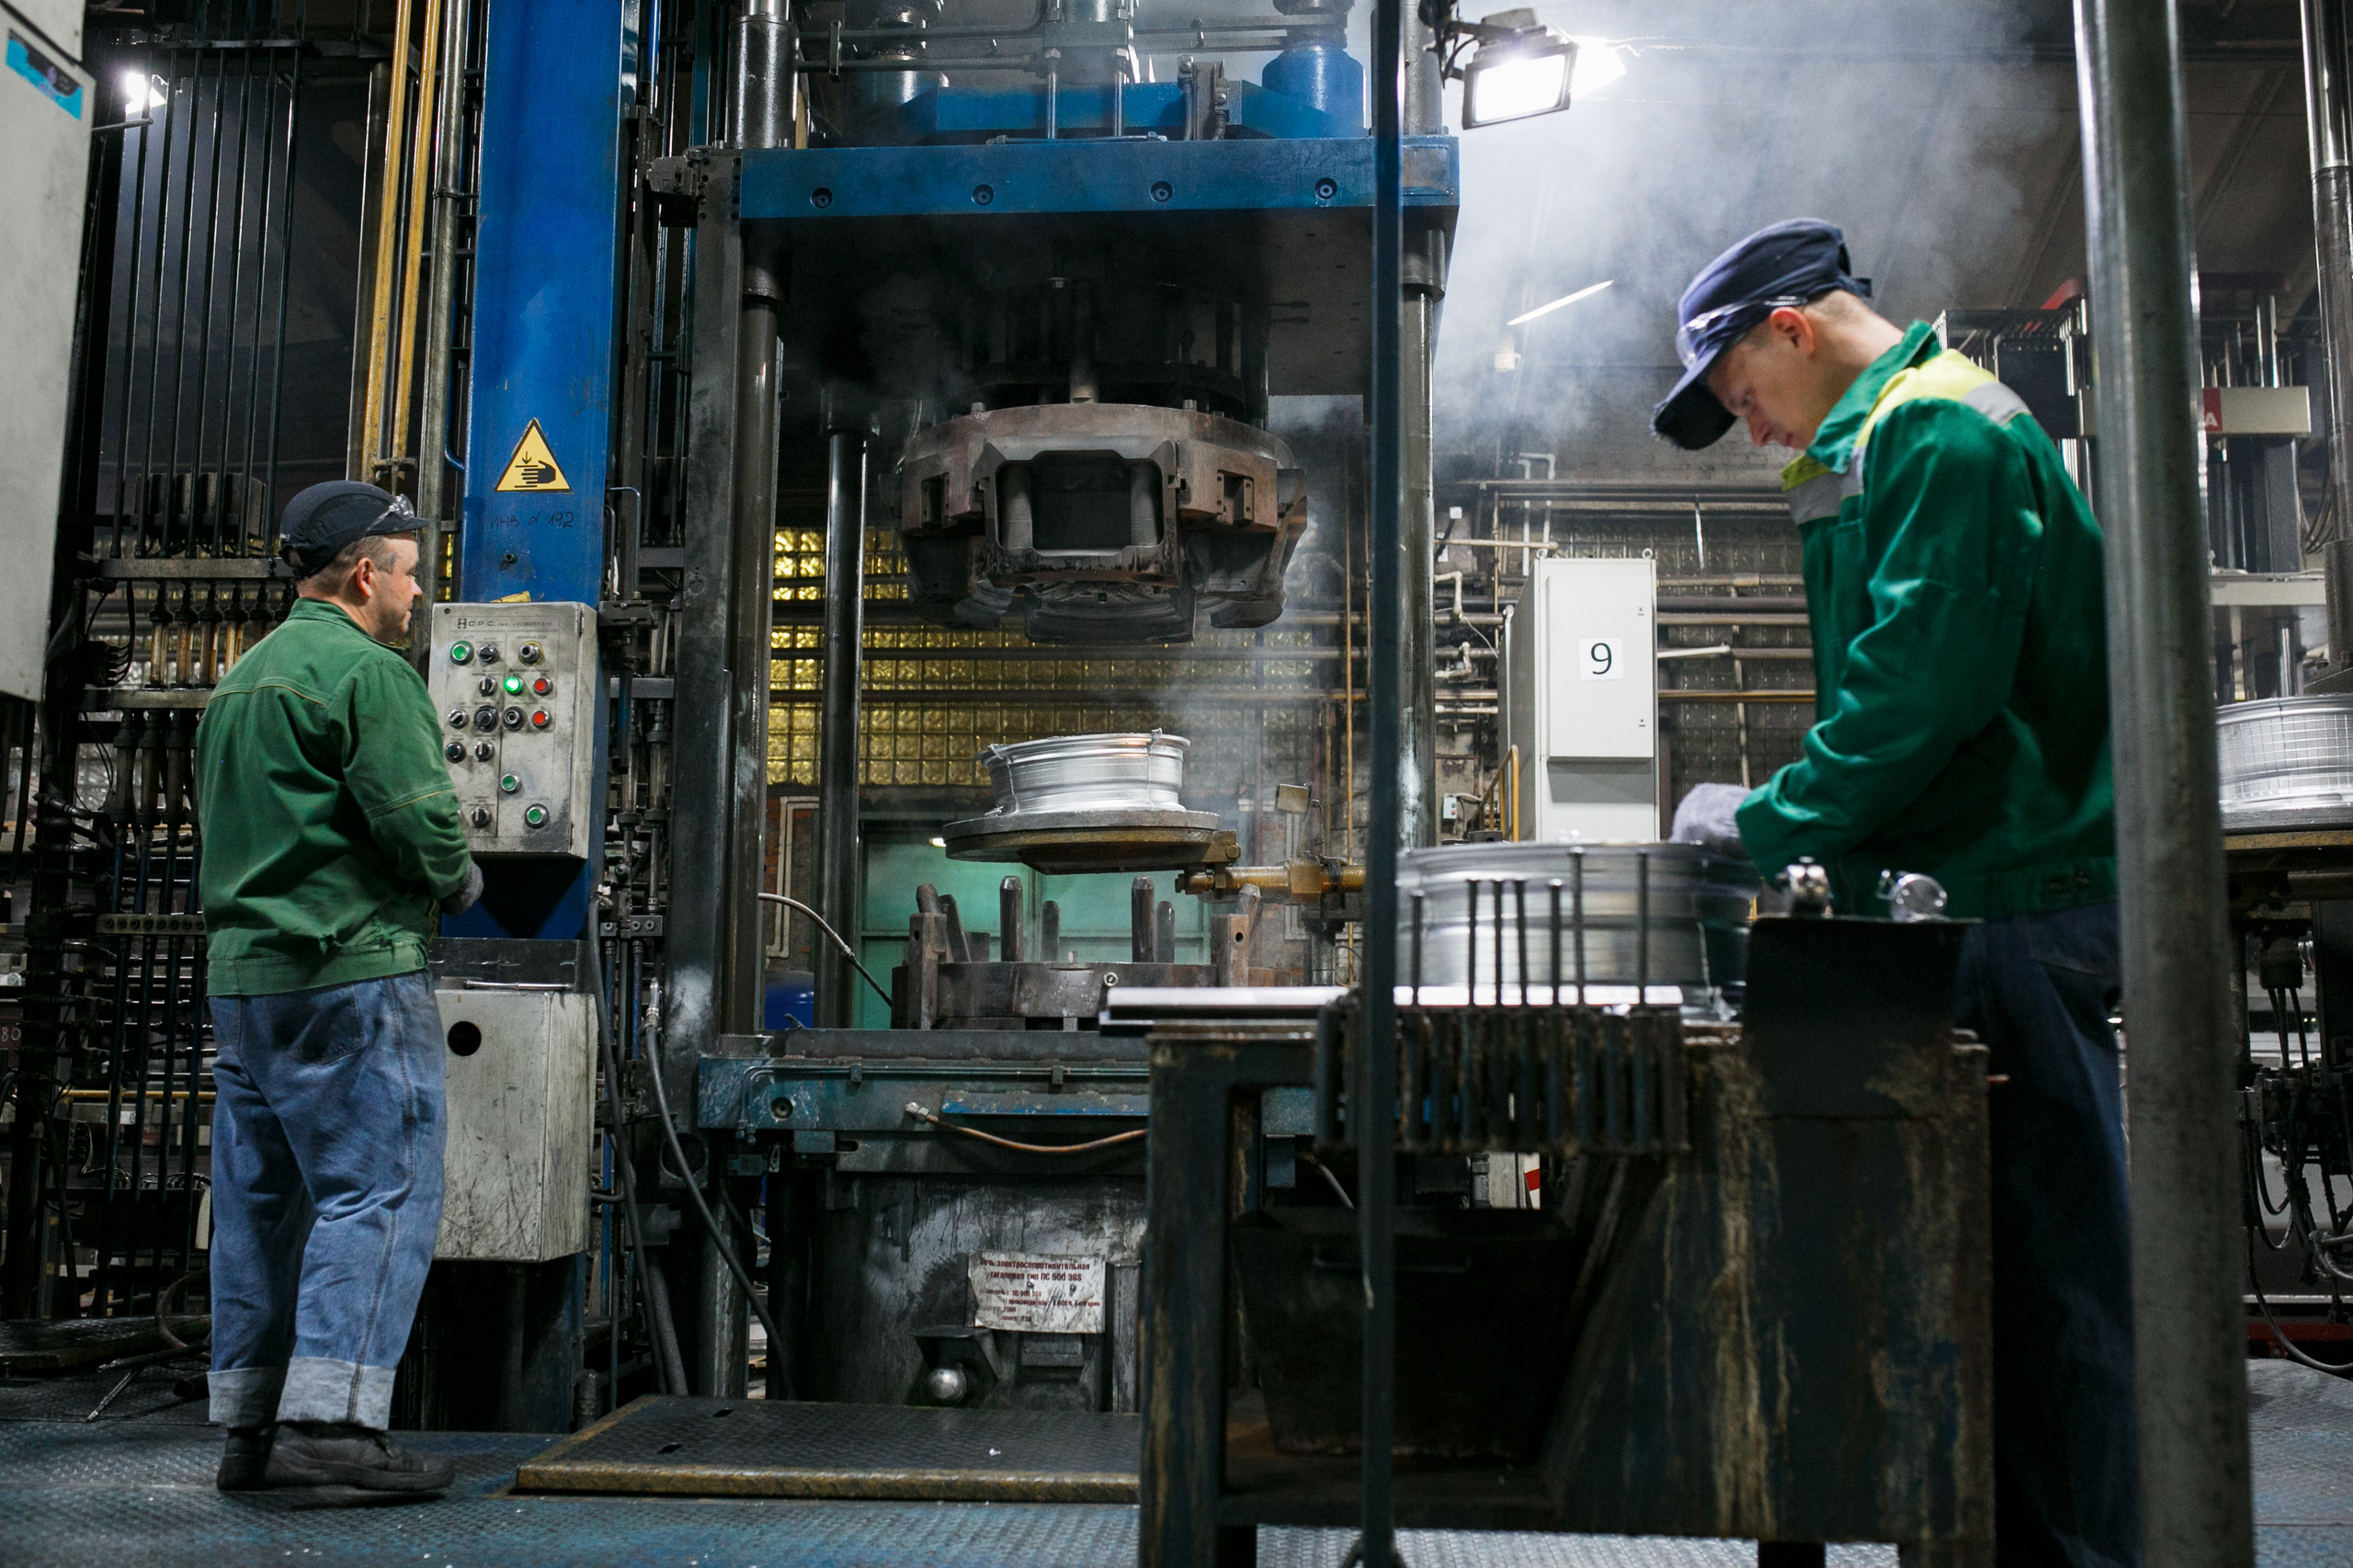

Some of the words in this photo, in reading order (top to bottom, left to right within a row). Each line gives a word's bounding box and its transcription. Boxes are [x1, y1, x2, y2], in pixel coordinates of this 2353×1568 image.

[548, 511, 574, 528] 192
[1590, 642, 1612, 675] 9
[980, 1258, 995, 1267] Печь
[1027, 1273, 1039, 1281] тип
[1052, 1273, 1066, 1281] 500
